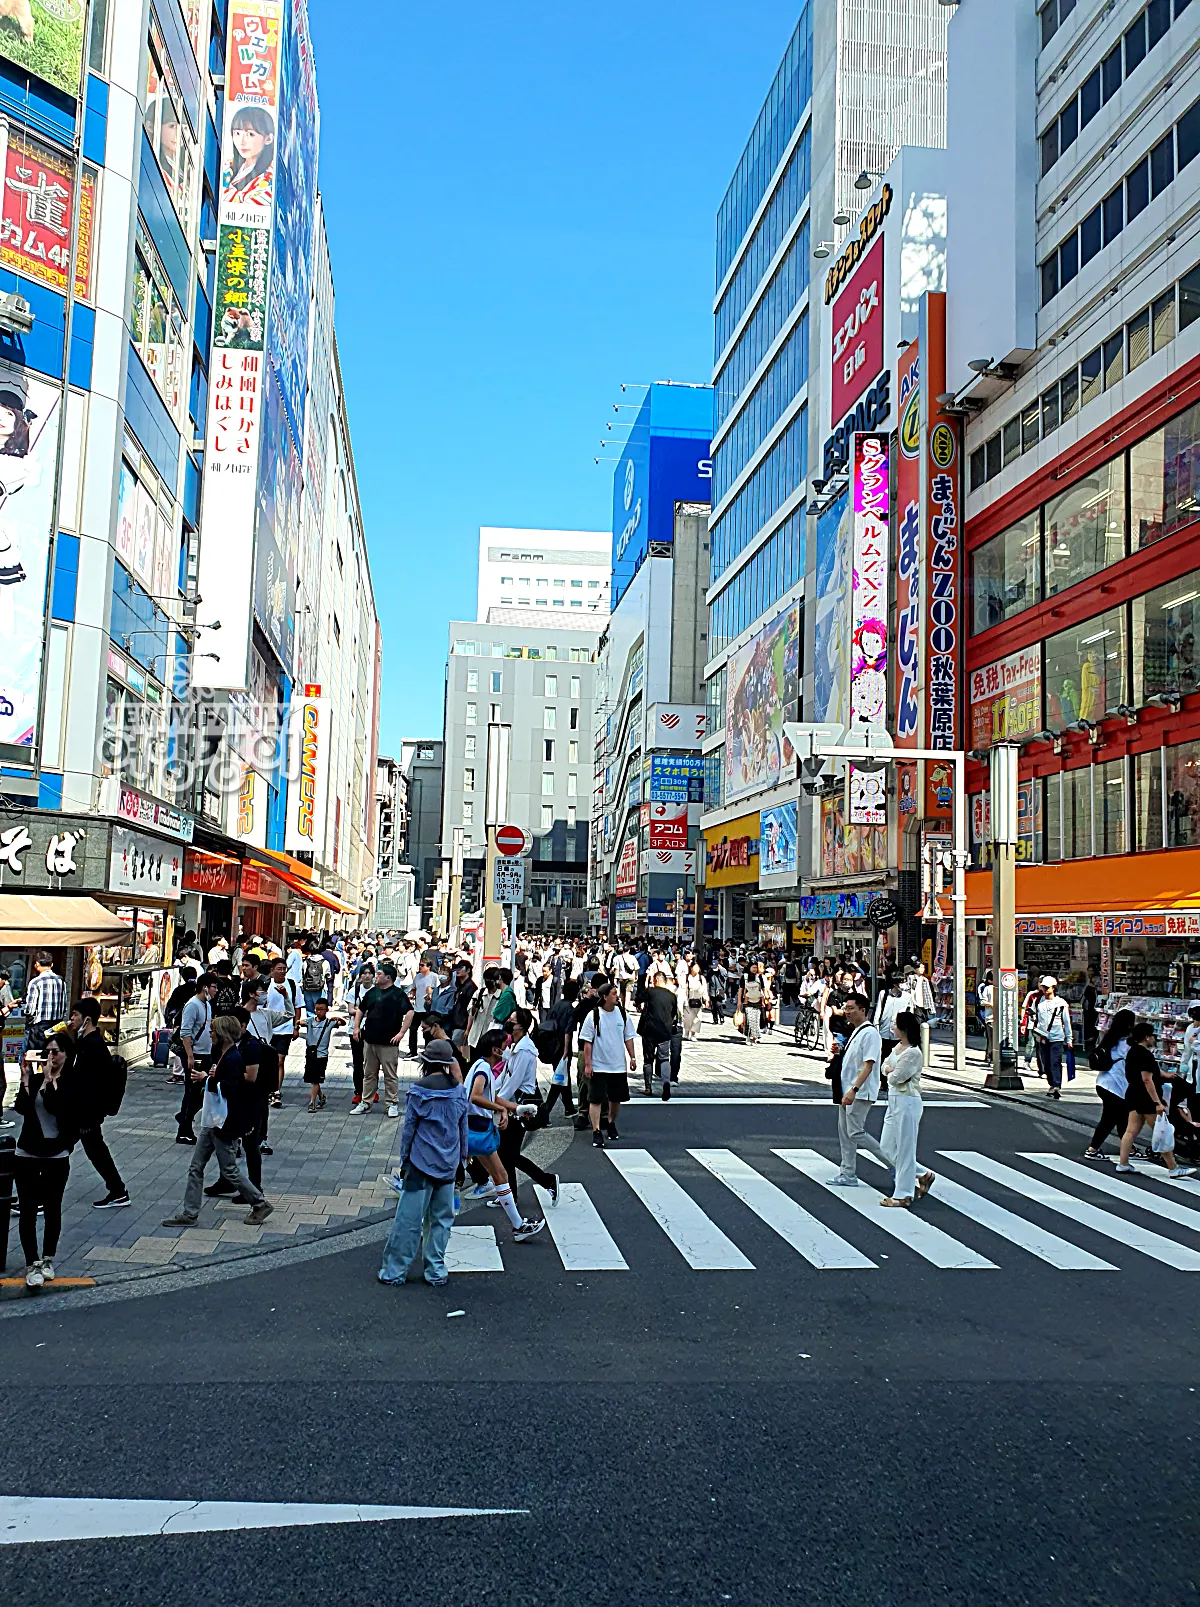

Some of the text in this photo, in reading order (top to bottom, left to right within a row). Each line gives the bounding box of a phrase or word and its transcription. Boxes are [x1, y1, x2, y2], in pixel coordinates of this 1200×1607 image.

[235, 93, 269, 105] AKIBA
[833, 280, 879, 363] エスパス
[823, 370, 890, 480] ESPACE
[973, 654, 1040, 699] 免税 Tax-Free
[298, 703, 320, 843] GAMERS
[654, 823, 683, 834] アコム
[1167, 917, 1187, 934] 免税
[1187, 925, 1200, 934] Free
